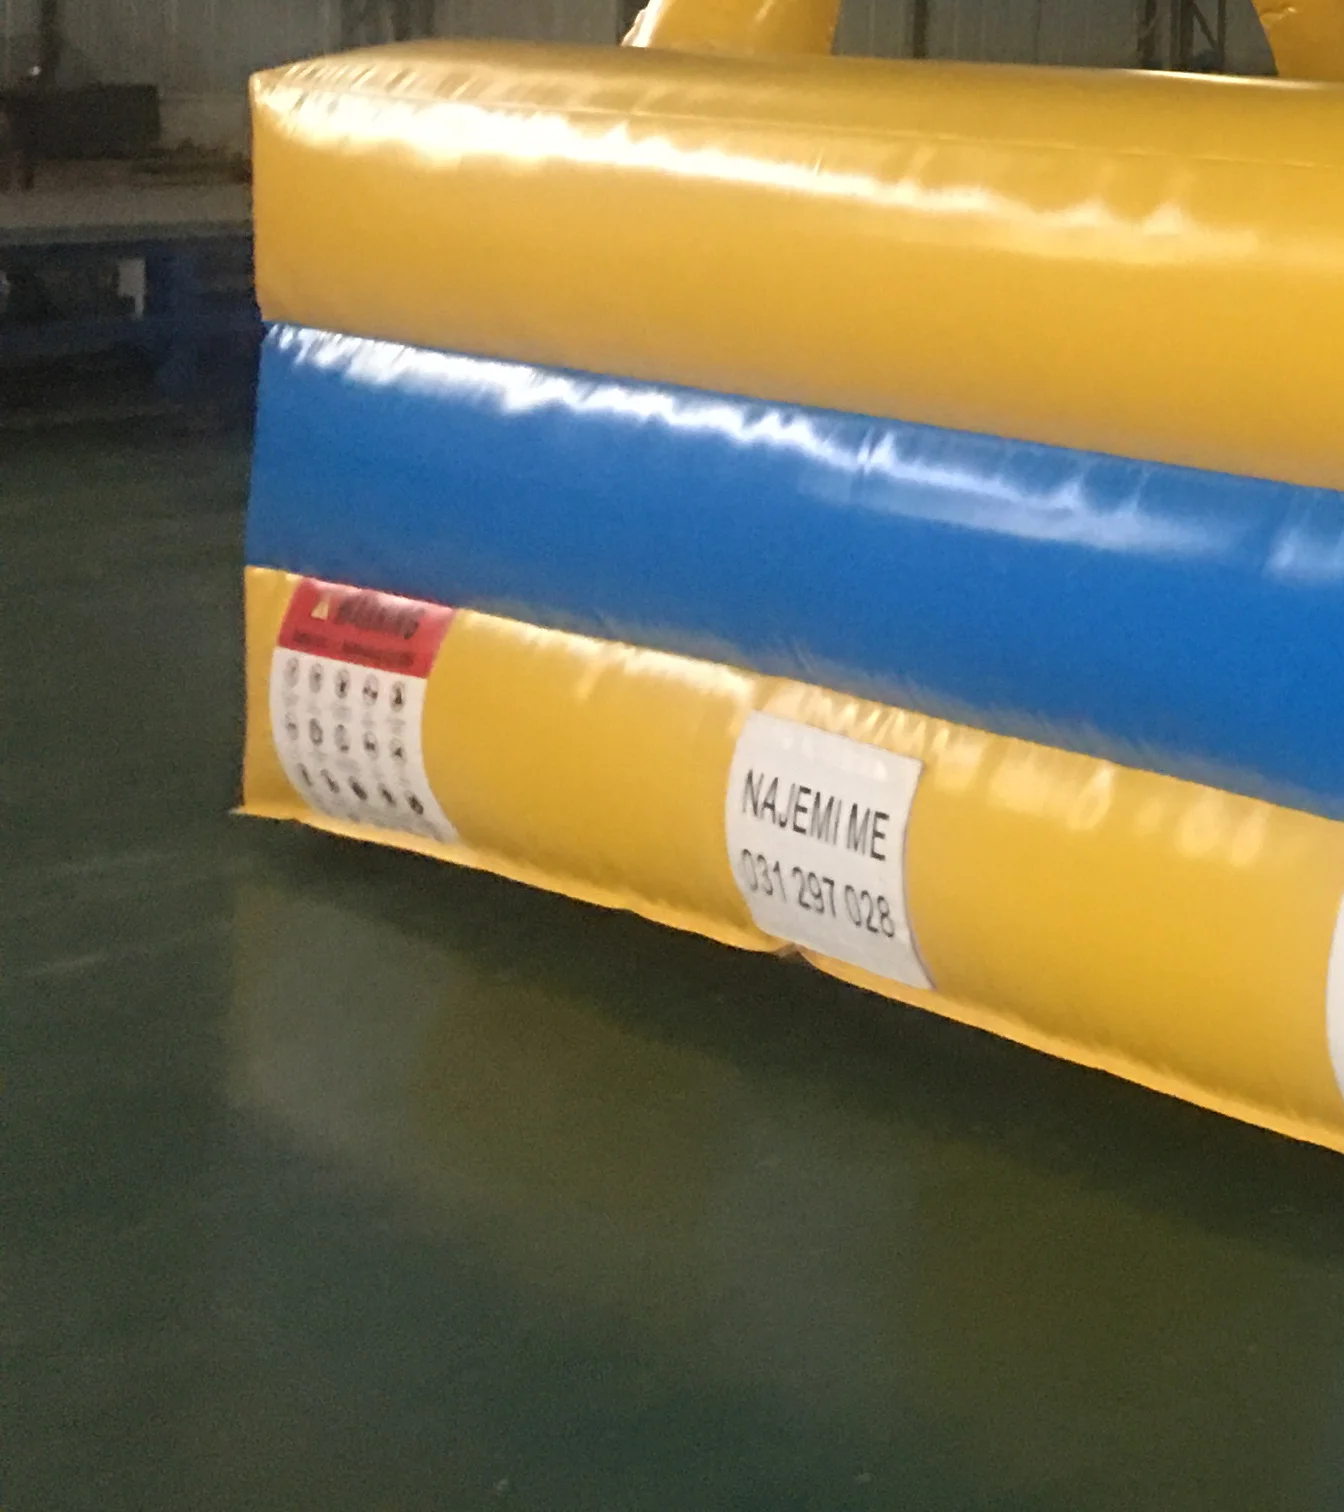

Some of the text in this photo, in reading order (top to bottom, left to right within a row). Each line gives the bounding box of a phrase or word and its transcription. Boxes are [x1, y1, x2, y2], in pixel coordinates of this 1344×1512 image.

[742, 769, 890, 861] NAJEMI ME
[741, 848, 895, 938] 031 297 028
